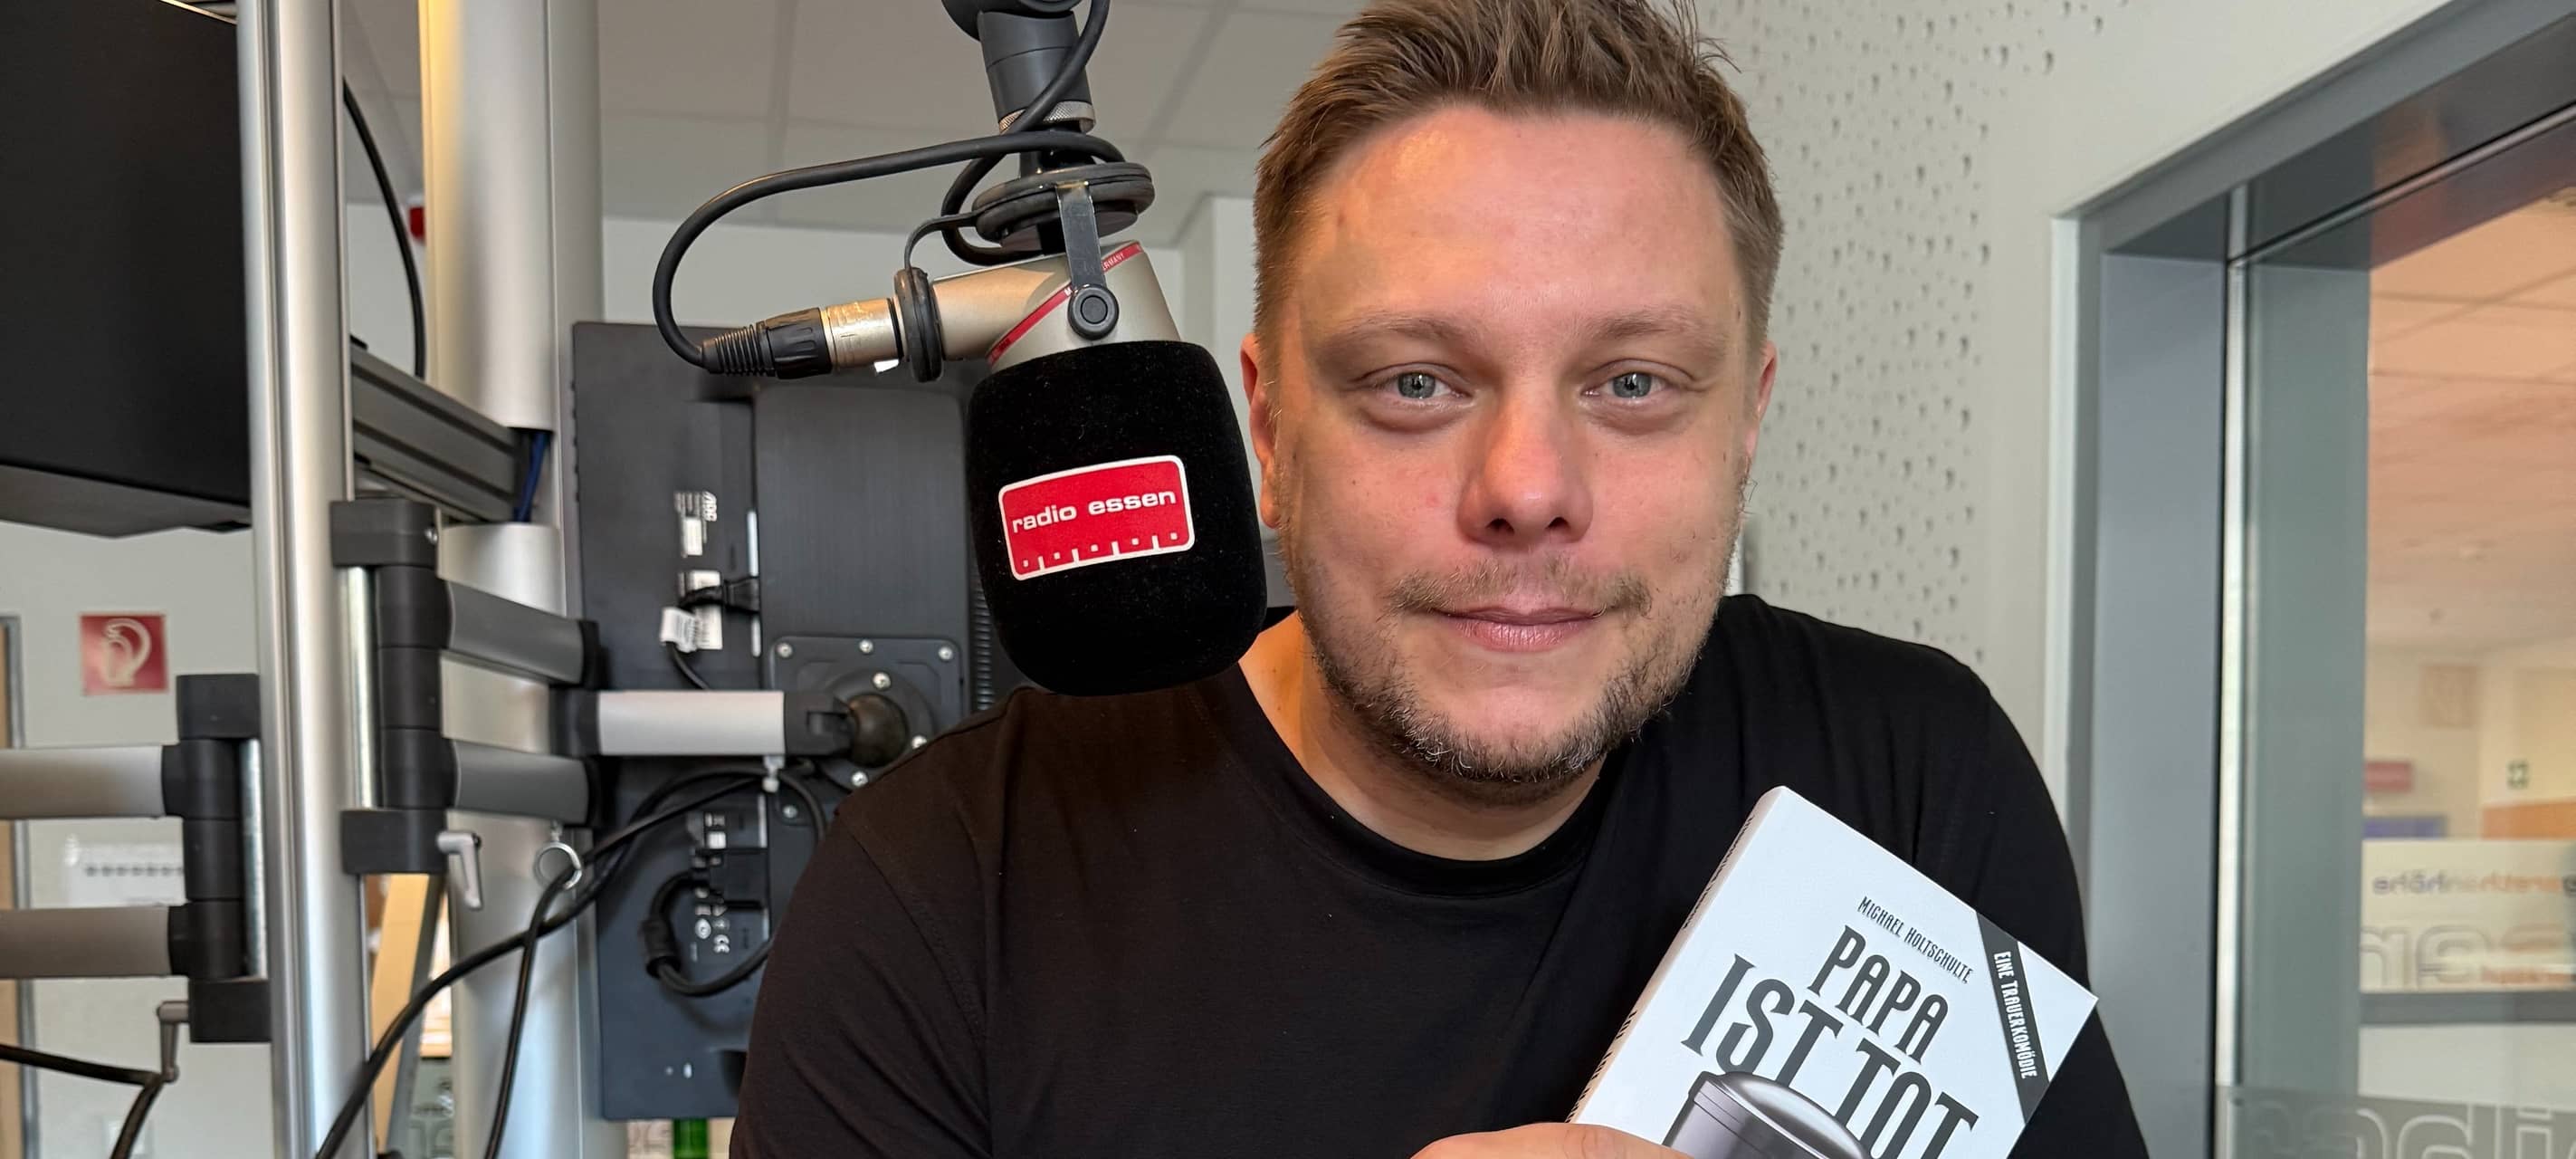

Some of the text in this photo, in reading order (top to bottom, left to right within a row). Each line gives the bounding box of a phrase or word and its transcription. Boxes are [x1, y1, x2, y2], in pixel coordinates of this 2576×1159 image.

[1012, 491, 1177, 533] radio essen
[1807, 924, 1949, 1065] PAPA
[1857, 896, 1974, 984] MICHAEL HOLTSCHULTE
[1680, 953, 1844, 1087] IST
[1831, 1038, 1979, 1159] TOT
[1993, 951, 2037, 1079] EINE TRAUERKOMÖDIE
